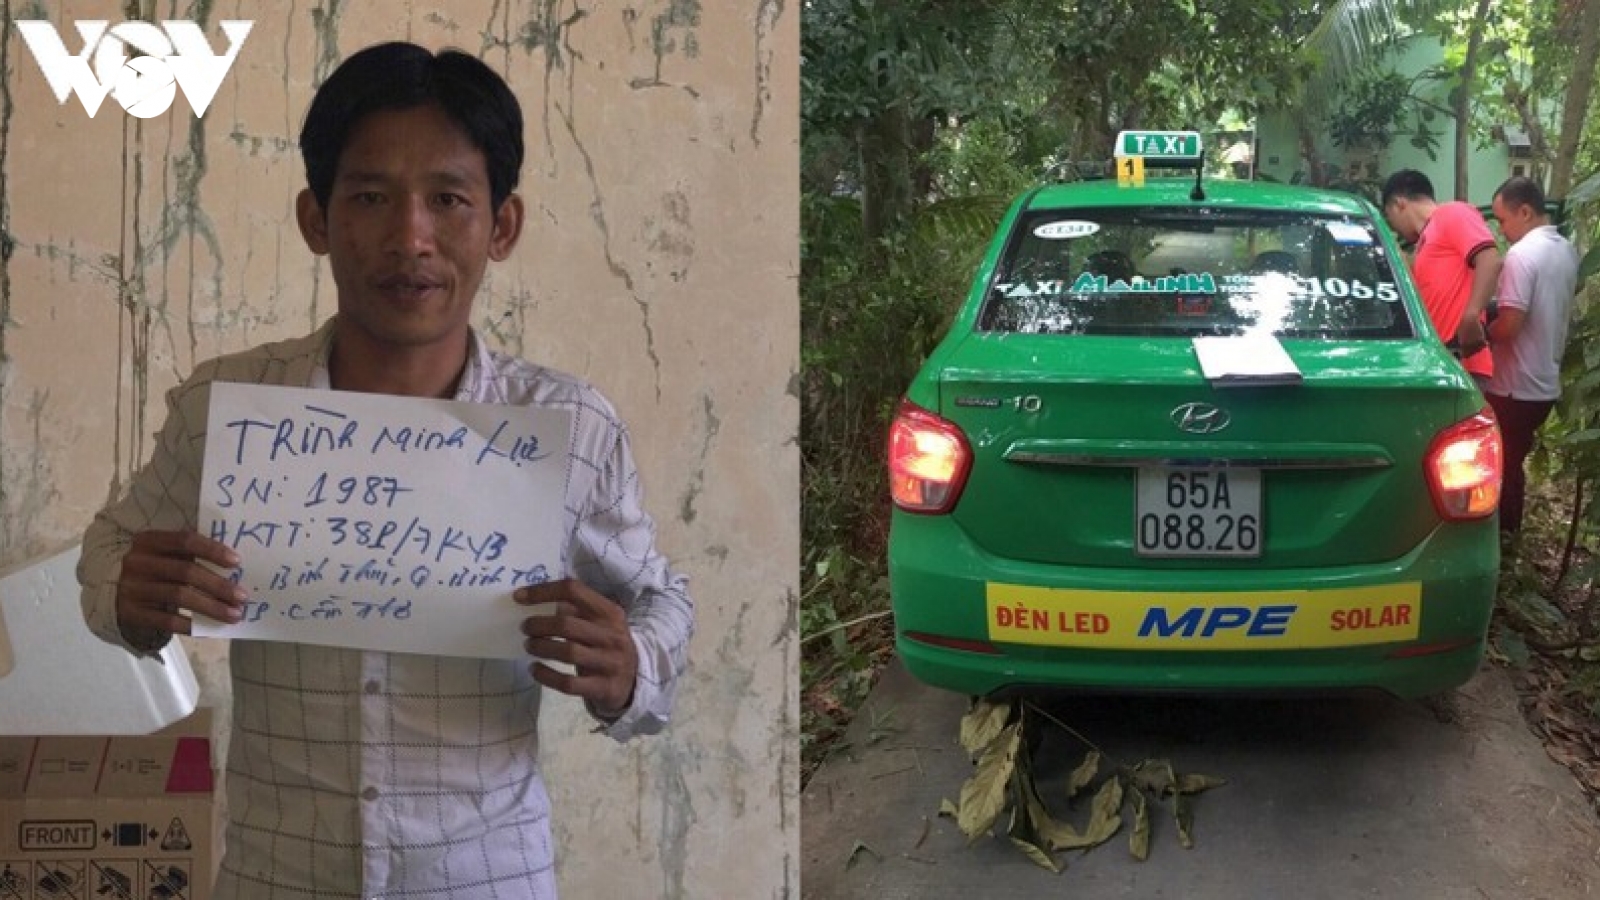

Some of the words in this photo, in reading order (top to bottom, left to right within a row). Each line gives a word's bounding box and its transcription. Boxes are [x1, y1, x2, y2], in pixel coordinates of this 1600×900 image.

[1125, 158, 1135, 176] 1
[217, 474, 288, 508] SN:
[304, 472, 413, 508] 1987
[1166, 471, 1232, 510] 65A
[1139, 513, 1257, 551] 088.26
[995, 601, 1050, 632] ĐÈN
[1058, 610, 1111, 635] LED
[1137, 605, 1298, 638] MPE
[1329, 603, 1411, 632] SOLAR
[25, 826, 92, 845] FRONT
